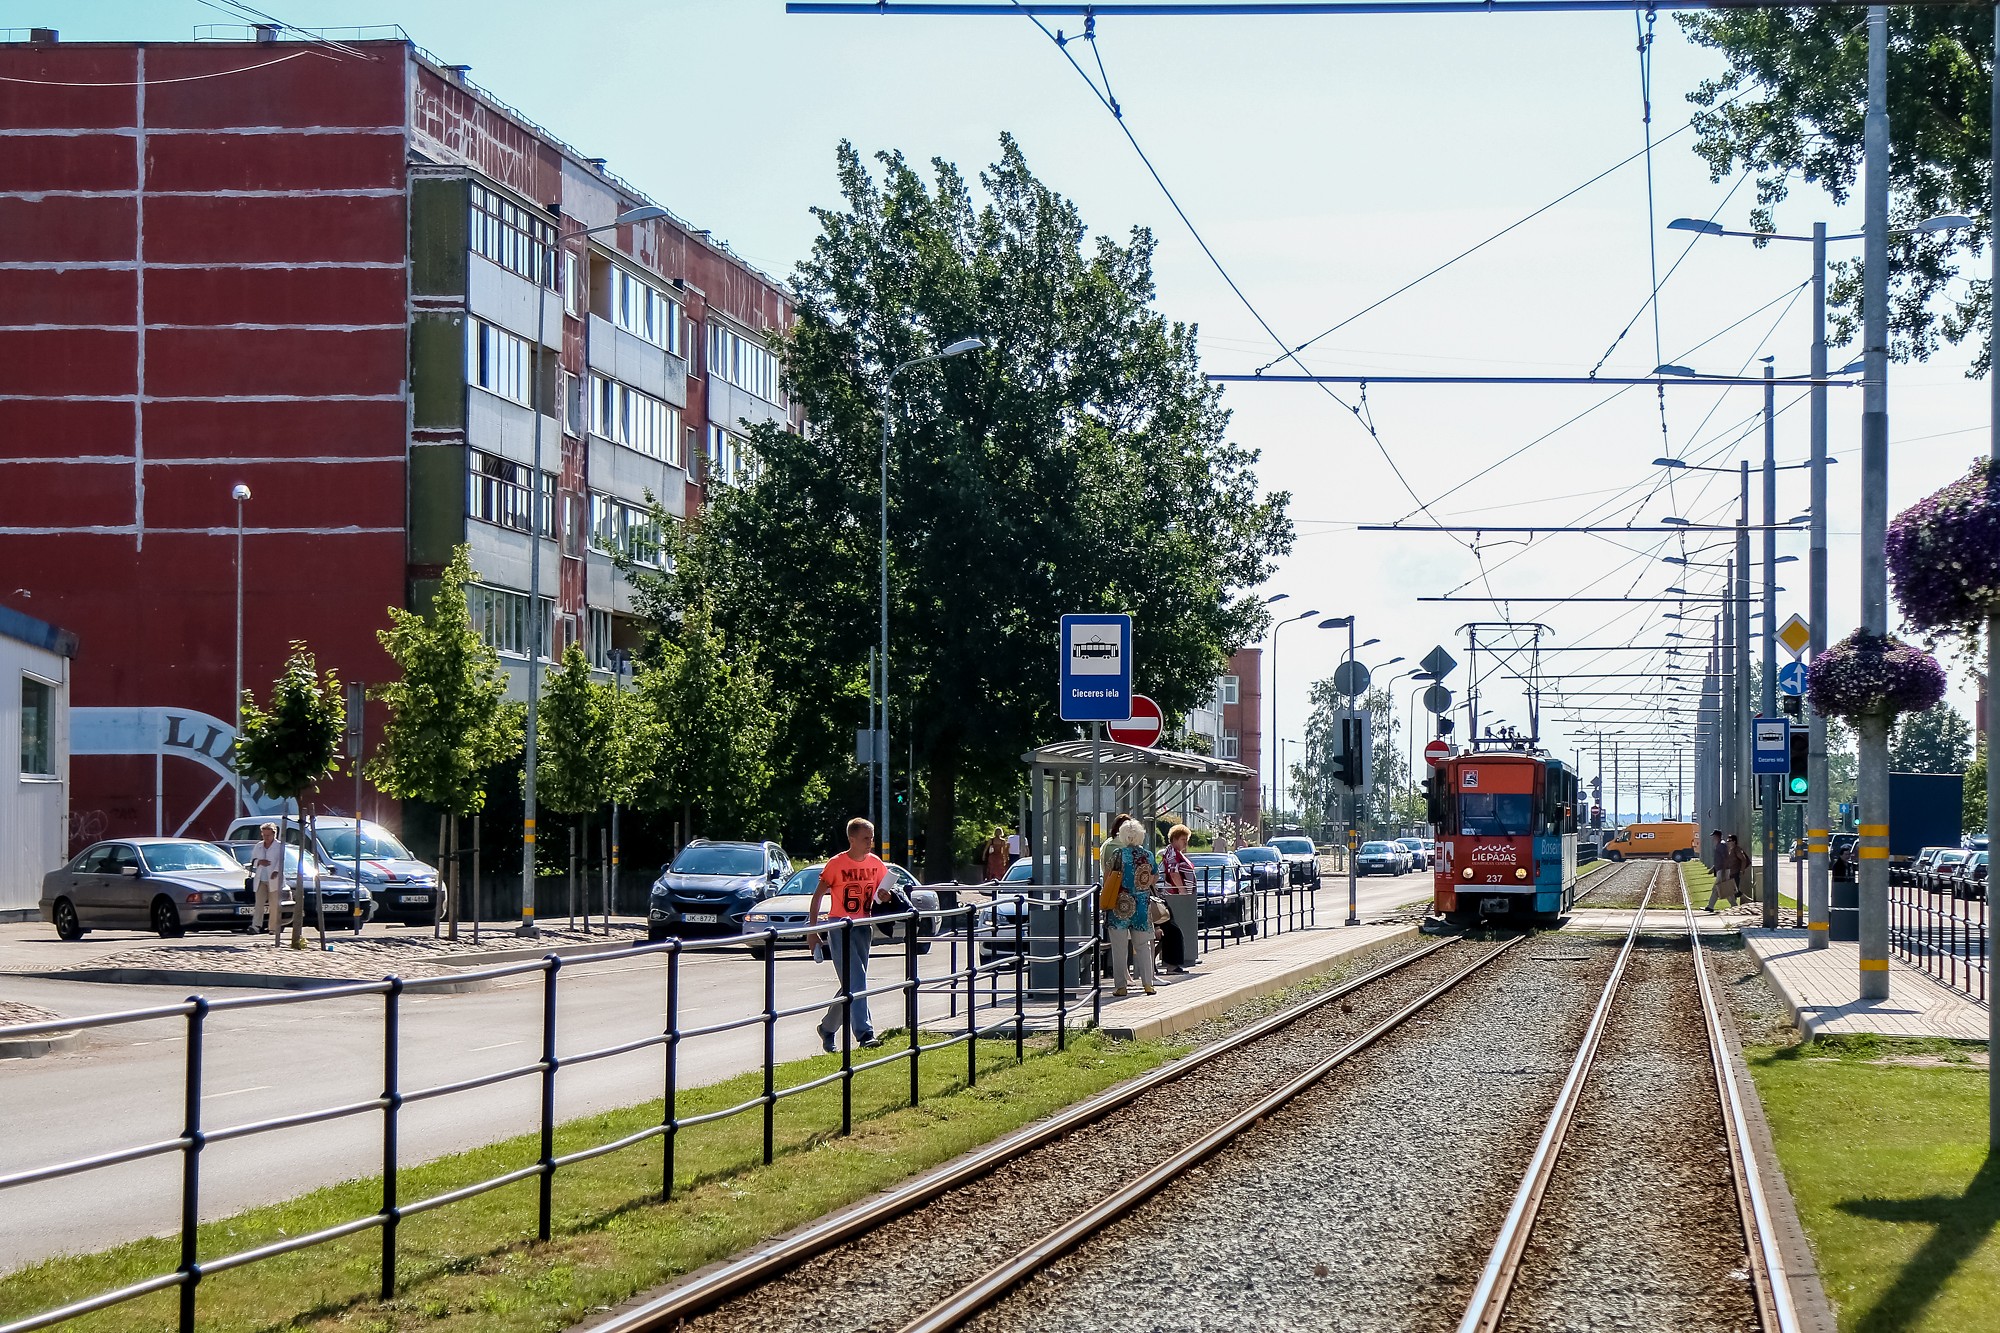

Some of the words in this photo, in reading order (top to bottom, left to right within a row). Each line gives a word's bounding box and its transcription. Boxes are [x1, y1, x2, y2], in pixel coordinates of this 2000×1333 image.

[1072, 688, 1104, 698] Cieceres
[1105, 688, 1119, 698] iela
[1486, 874, 1503, 883] 237
[322, 903, 348, 911] P-2629
